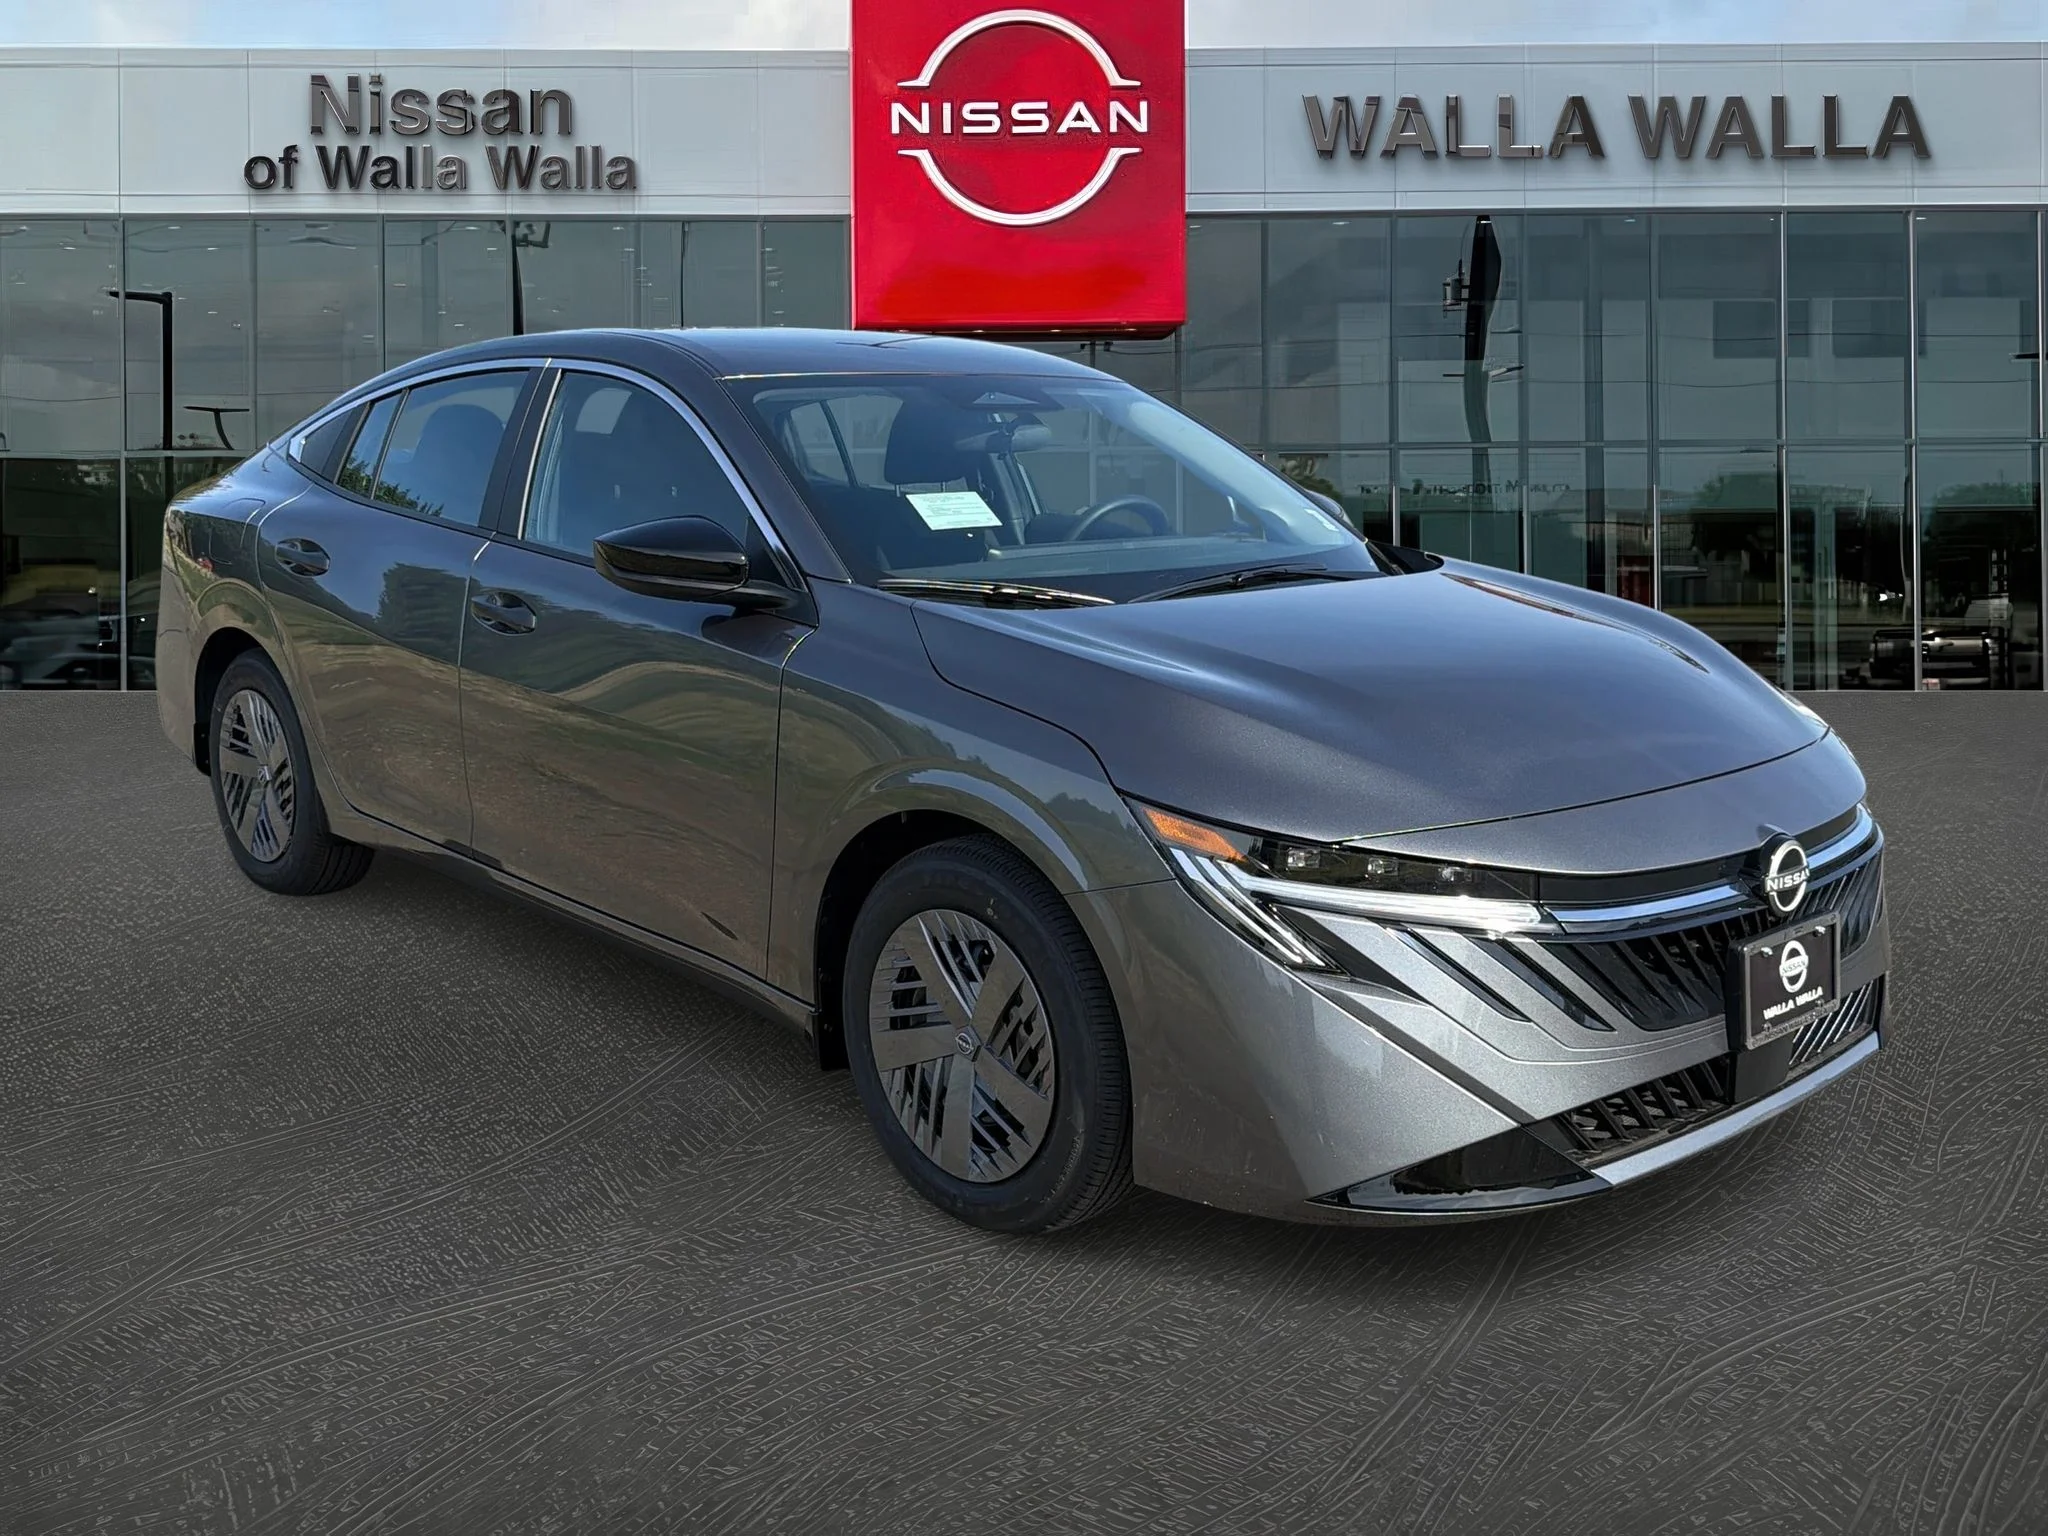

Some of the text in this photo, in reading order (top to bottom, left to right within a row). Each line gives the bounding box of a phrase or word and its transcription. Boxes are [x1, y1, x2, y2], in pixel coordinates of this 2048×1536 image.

[310, 73, 573, 136] Nissan
[891, 100, 1148, 135] NISSAN
[1302, 94, 1931, 160] WALLA WALLA
[243, 144, 637, 190] of Walla Walla
[1763, 999, 1795, 1020] WALLA
[1795, 986, 1824, 1007] WALLA
